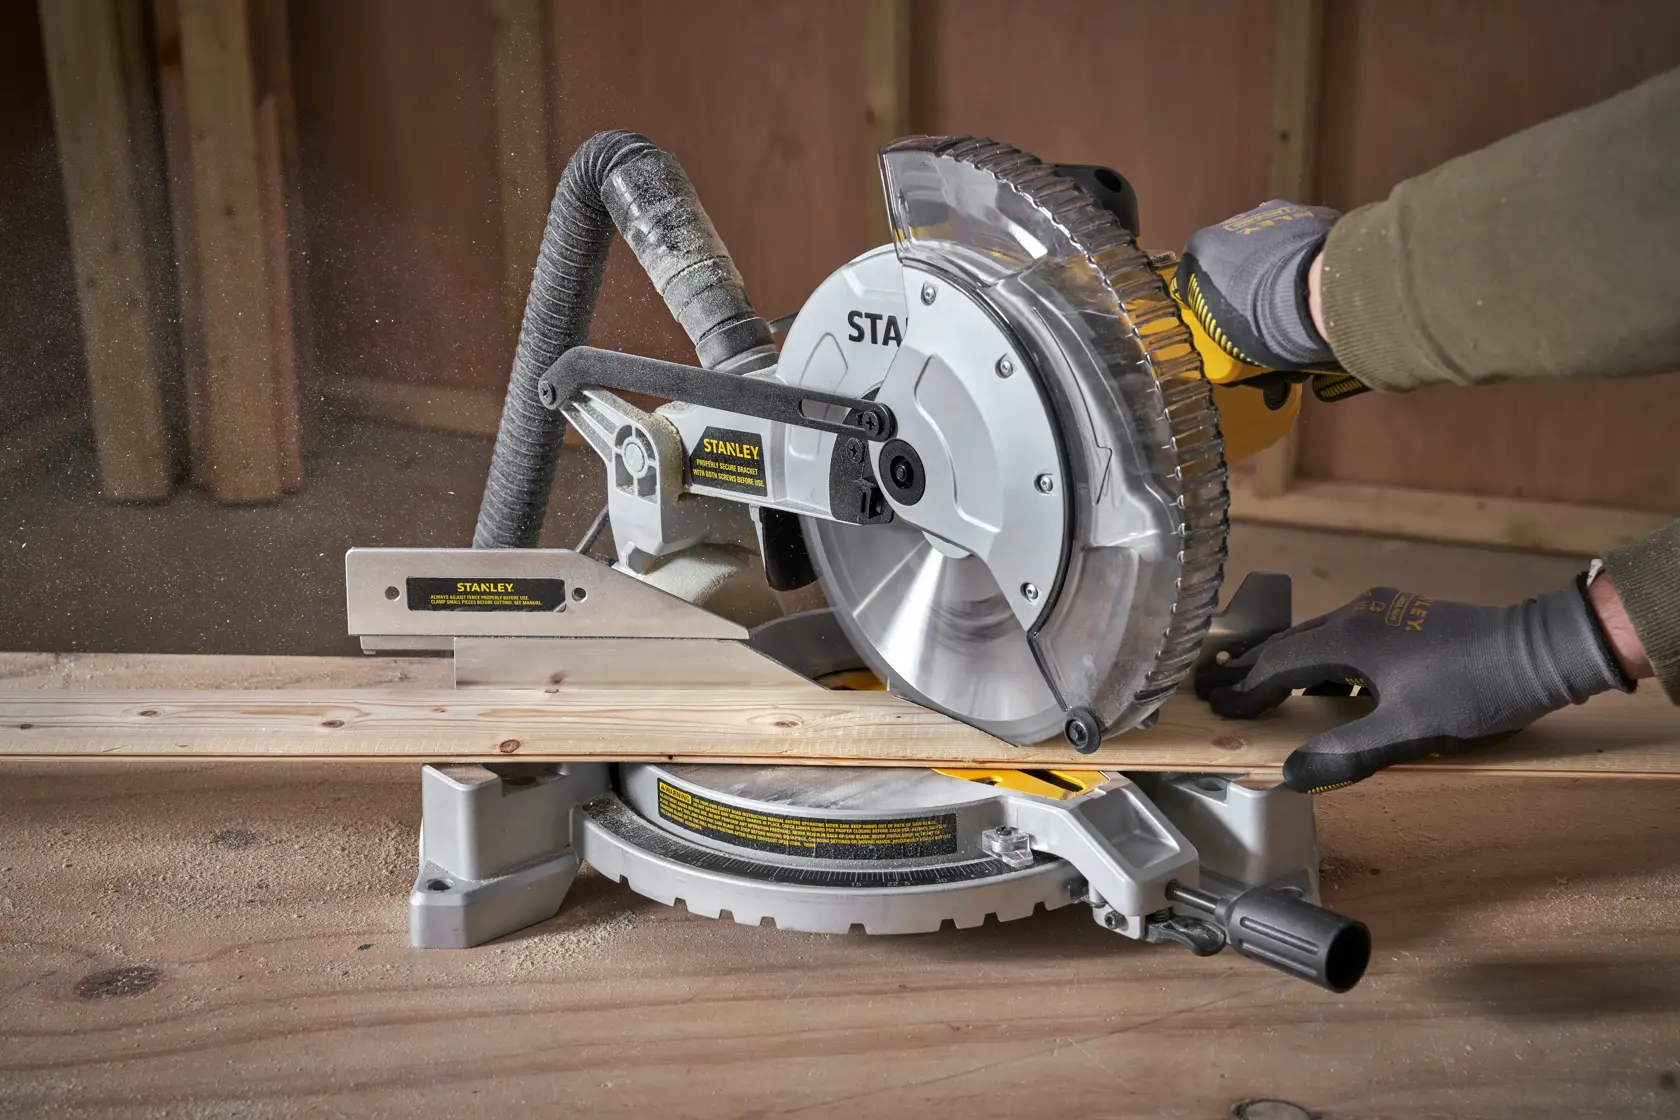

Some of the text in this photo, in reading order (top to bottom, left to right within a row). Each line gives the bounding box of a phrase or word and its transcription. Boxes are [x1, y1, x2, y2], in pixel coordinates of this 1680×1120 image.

[848, 310, 908, 348] STA
[704, 438, 759, 460] STANLEY
[696, 459, 758, 475] PROPERLY SECURE BRACKET
[693, 468, 705, 476] WITH
[706, 470, 717, 478] BOTH
[718, 472, 736, 482] SCREWS
[737, 476, 754, 485] BEFORE
[457, 583, 513, 592] STANLEY
[666, 786, 690, 802] WARNING
